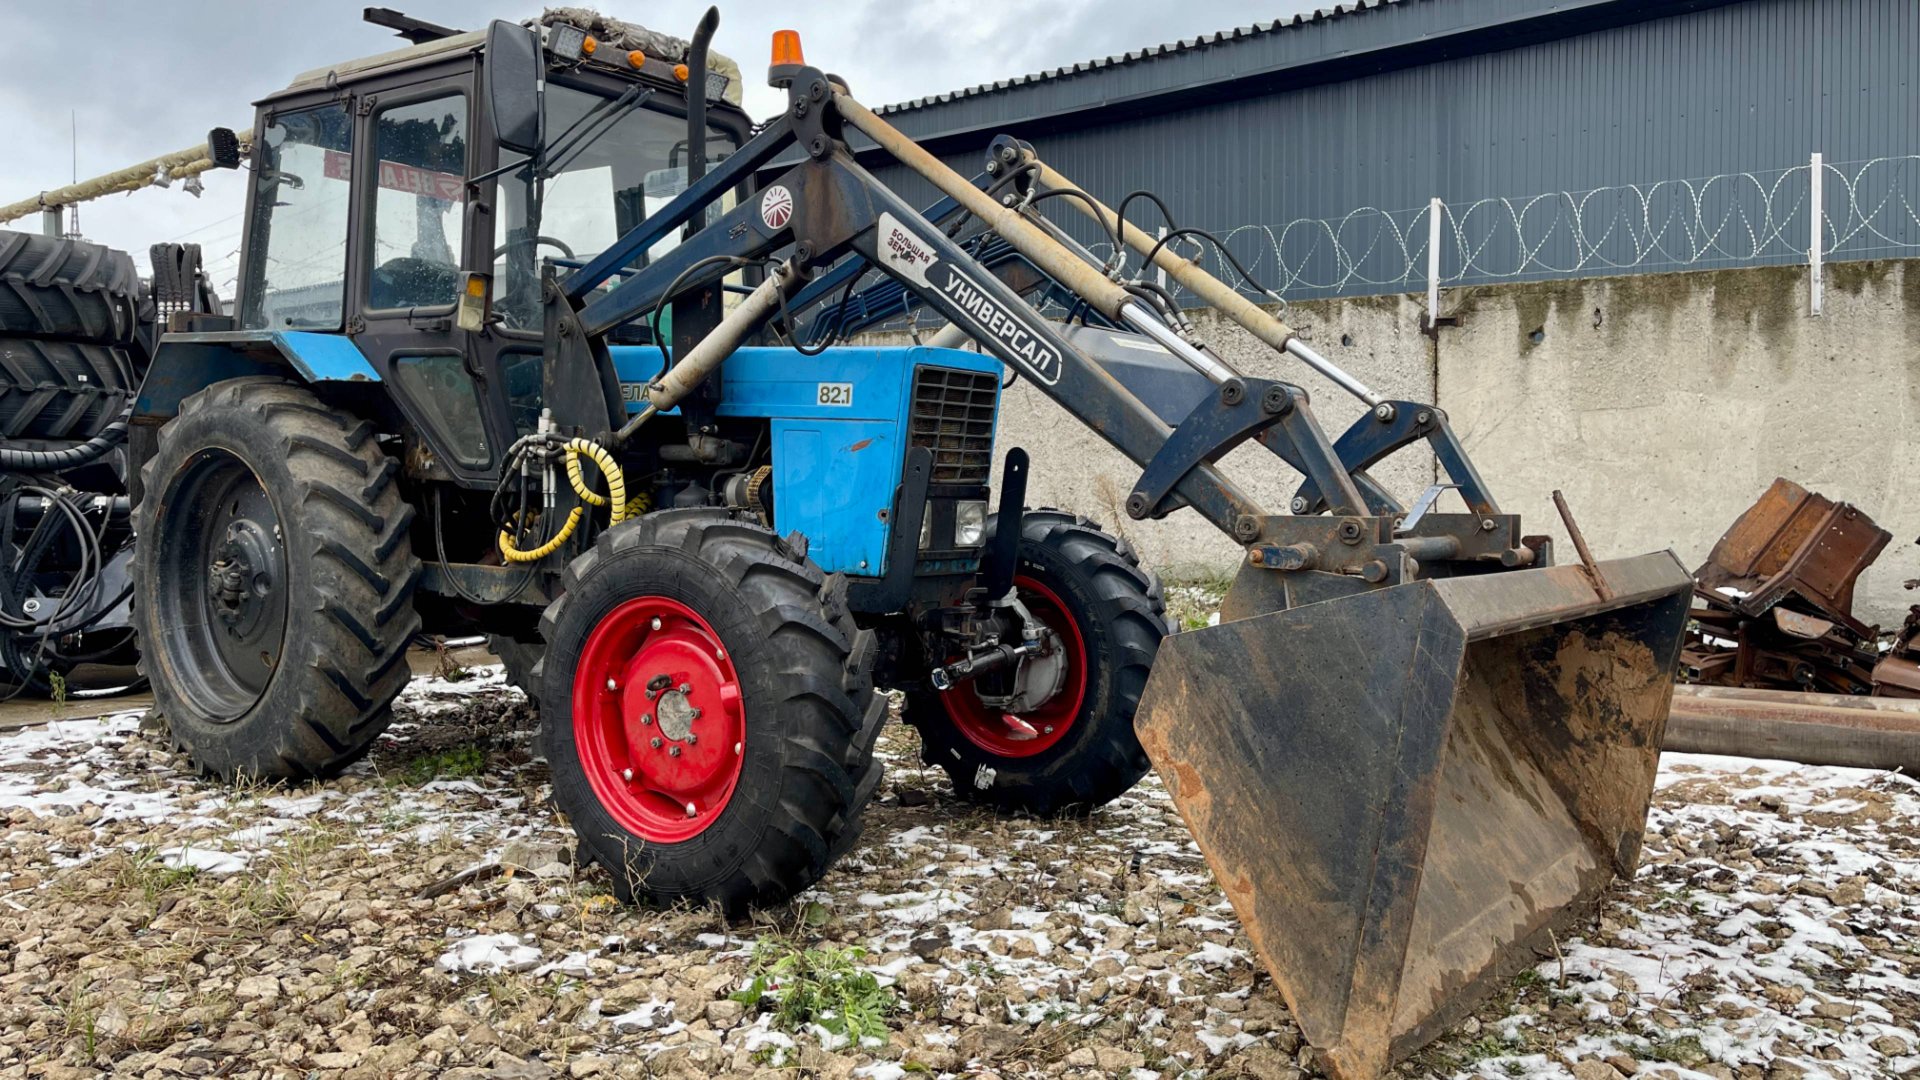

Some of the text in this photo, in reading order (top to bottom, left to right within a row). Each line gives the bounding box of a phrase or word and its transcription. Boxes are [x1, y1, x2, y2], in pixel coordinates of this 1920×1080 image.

[887, 237, 916, 265] ЗЕМЯ
[891, 228, 931, 264] БОЛЬШАЯ
[944, 272, 1052, 371] УНИВЕРСАЛ
[819, 385, 851, 405] 82.1
